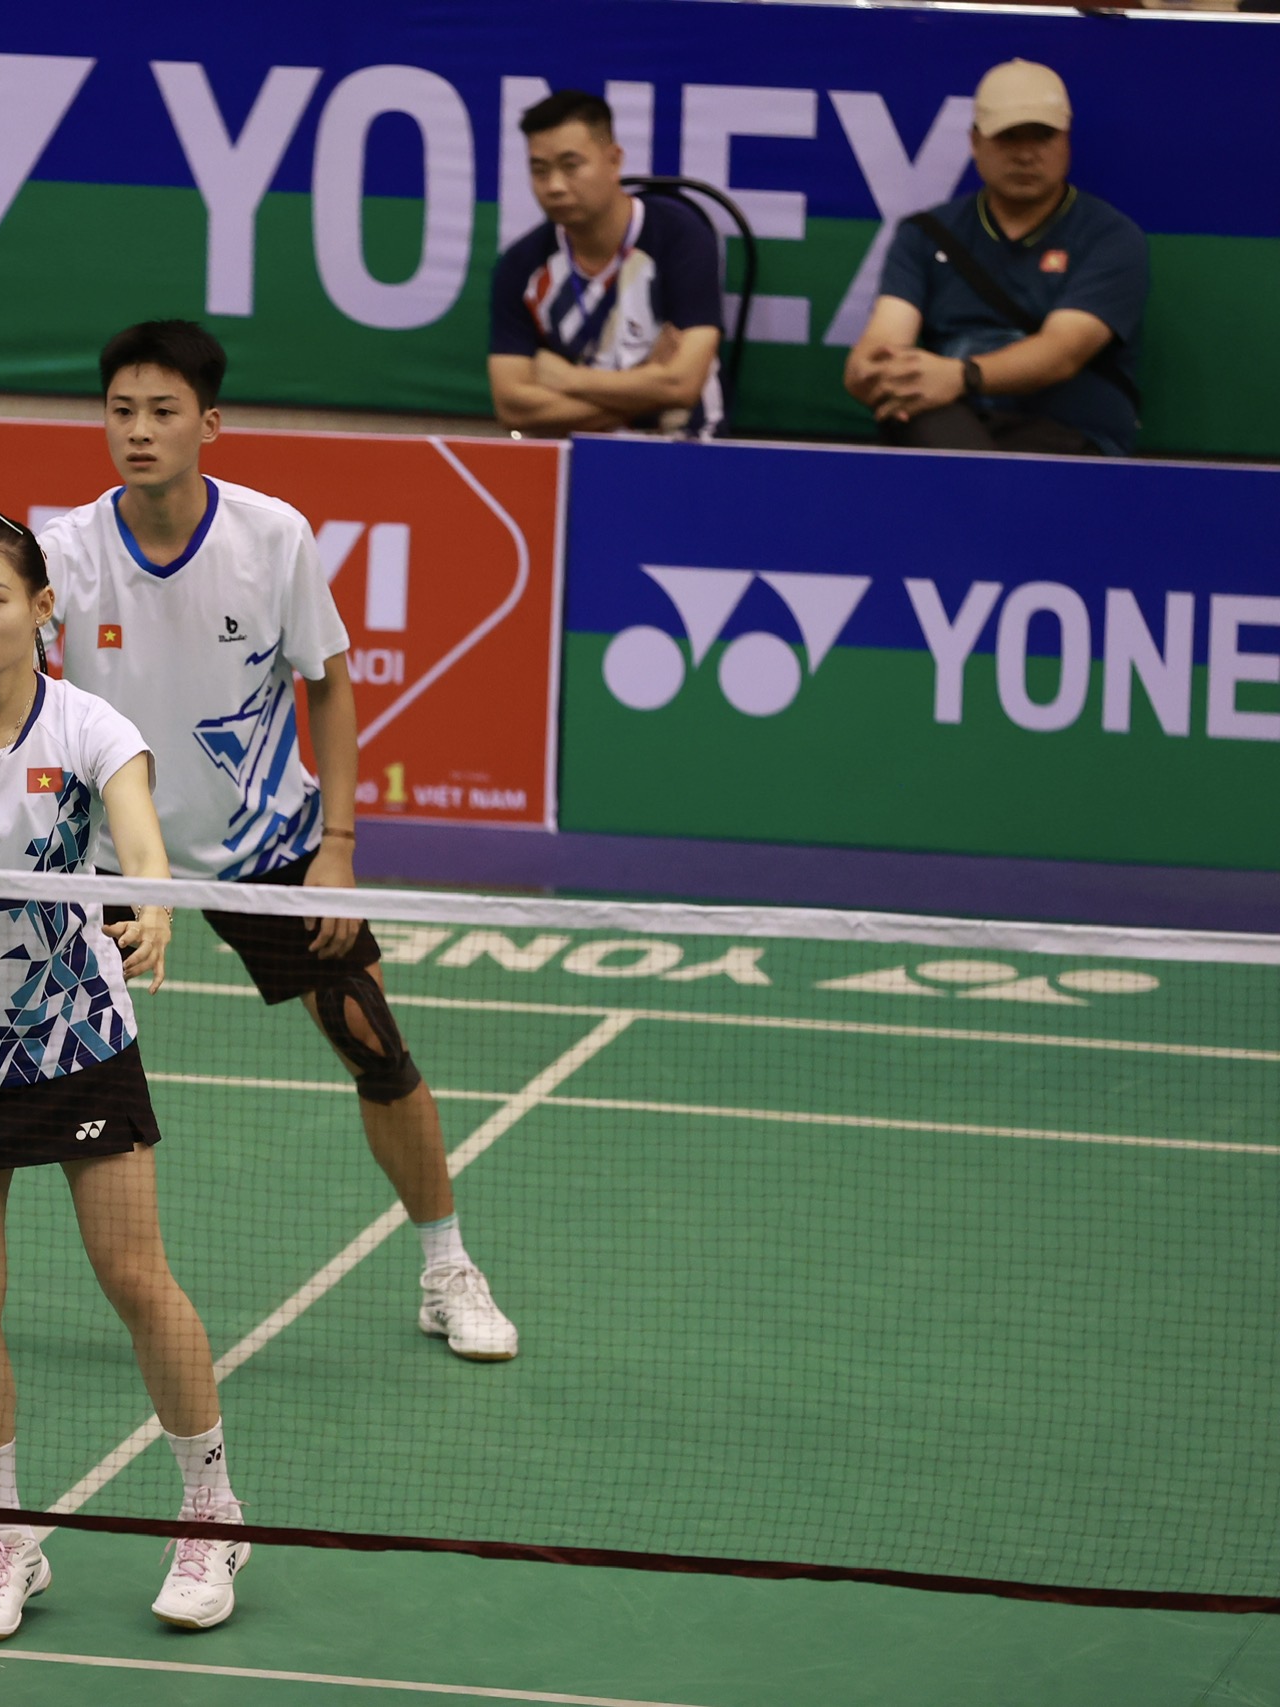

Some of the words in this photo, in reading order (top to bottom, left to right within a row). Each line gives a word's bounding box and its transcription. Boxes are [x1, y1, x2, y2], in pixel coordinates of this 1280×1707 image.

[902, 577, 1280, 742] YONE
[384, 761, 408, 804] 1
[215, 921, 772, 987] YONE
